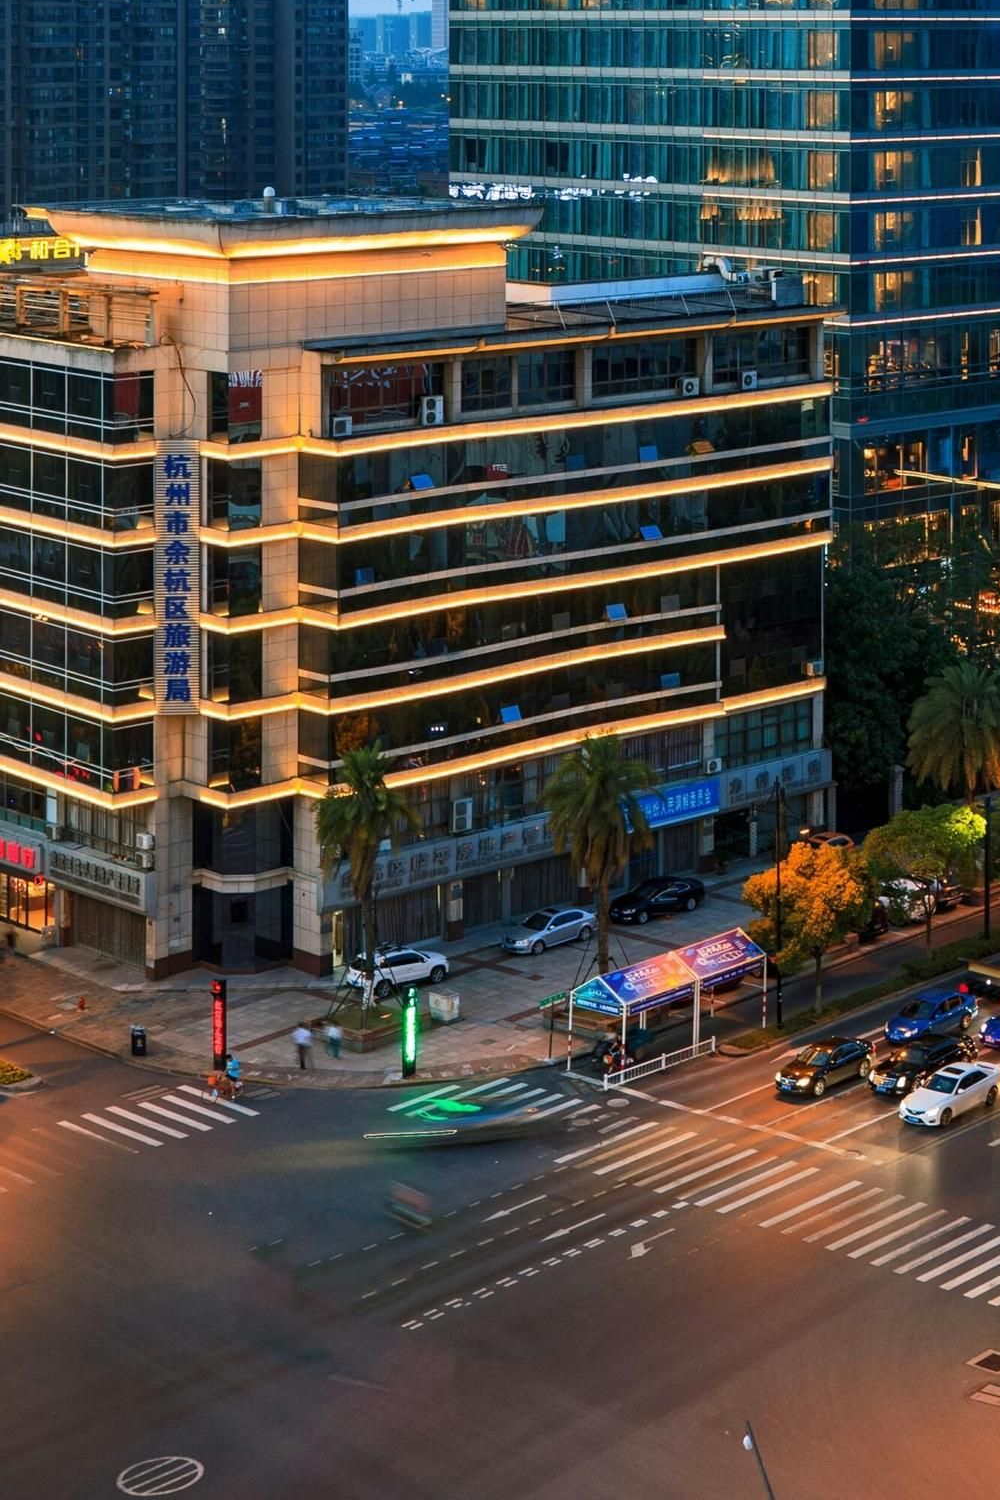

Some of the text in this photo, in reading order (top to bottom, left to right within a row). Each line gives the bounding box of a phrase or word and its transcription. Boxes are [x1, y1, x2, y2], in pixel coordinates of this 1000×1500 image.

[163, 454, 192, 702] 杭州市余杭区旅游局
